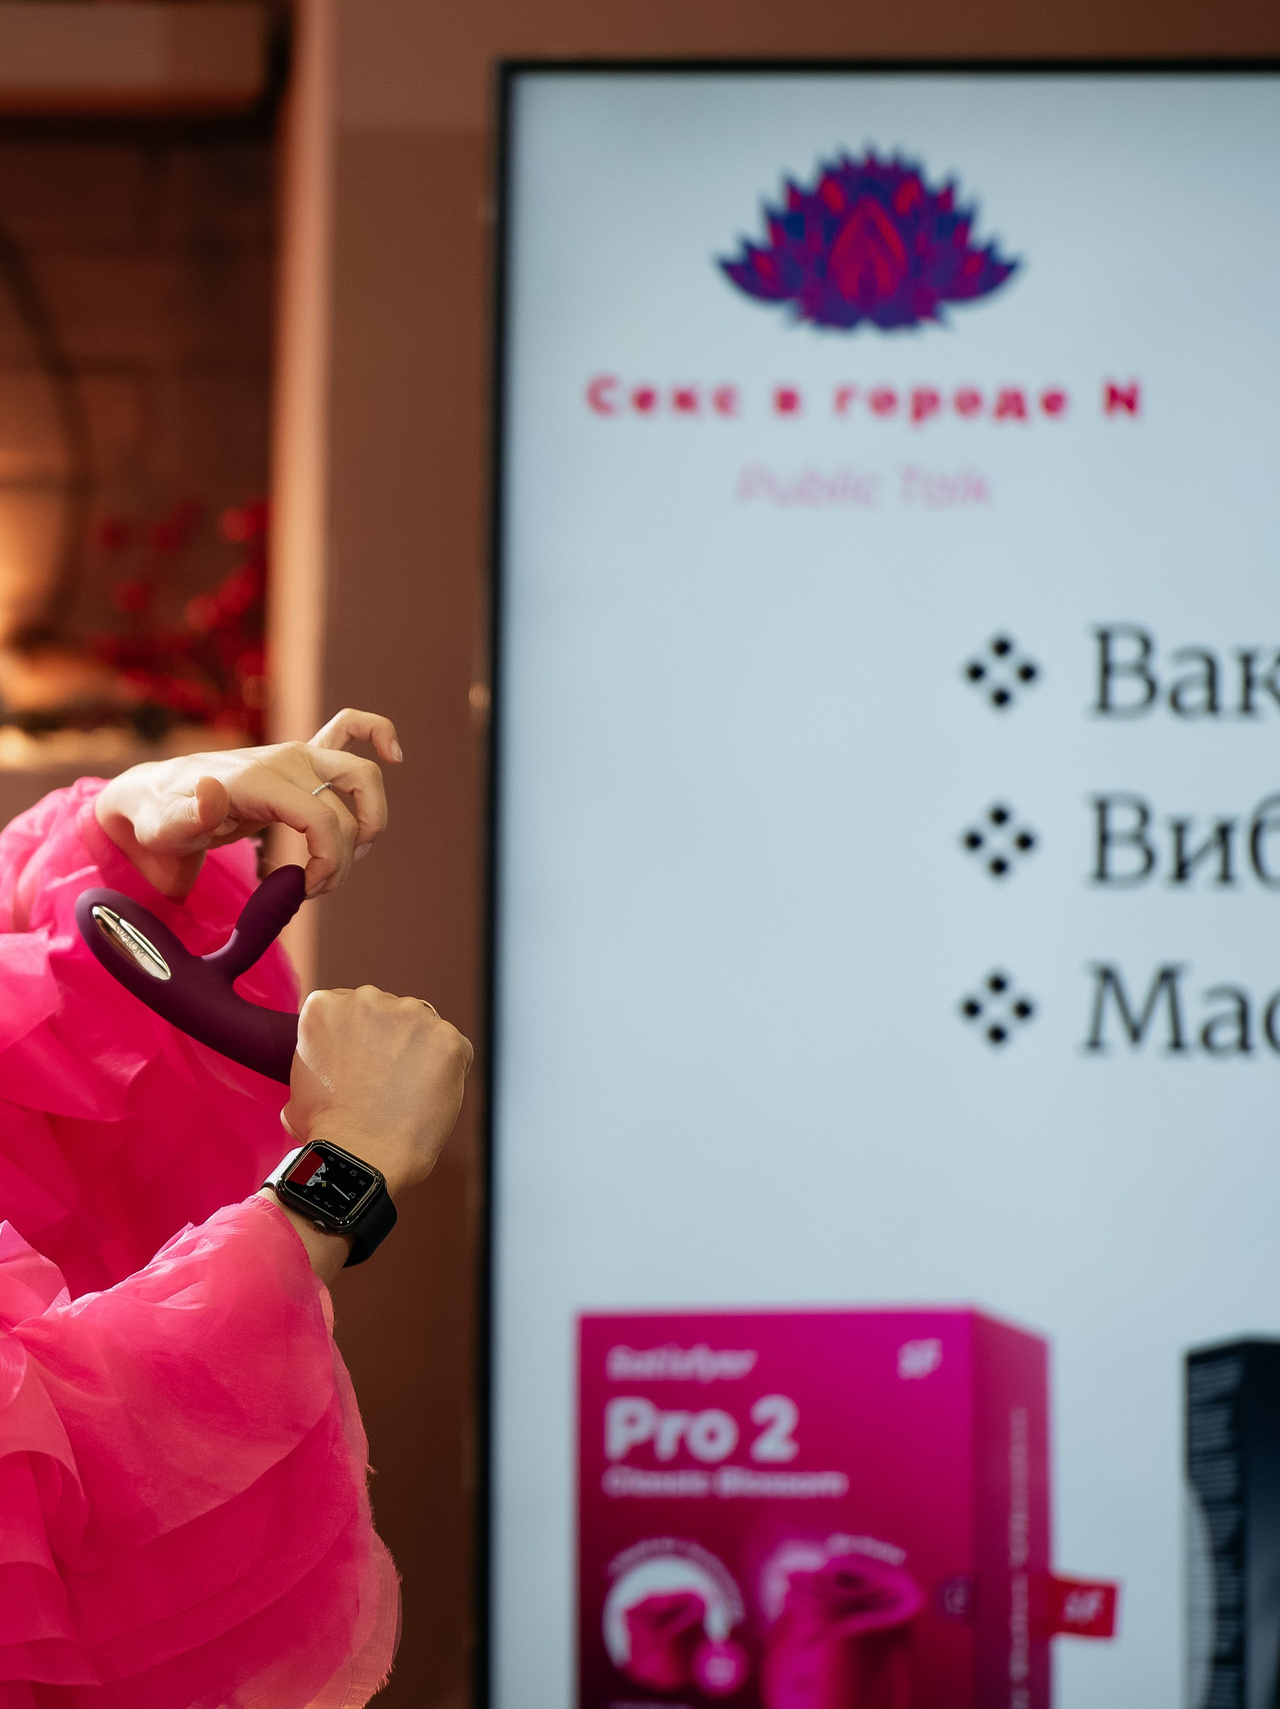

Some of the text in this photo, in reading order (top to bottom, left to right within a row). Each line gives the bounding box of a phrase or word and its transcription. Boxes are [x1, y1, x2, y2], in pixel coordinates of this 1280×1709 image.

[585, 375, 740, 419] Секс
[770, 384, 803, 418] в
[833, 383, 1067, 429] городе
[736, 464, 993, 508] Public Talk
[115, 924, 146, 959] SVAKOM
[605, 1395, 799, 1463] Pro 2
